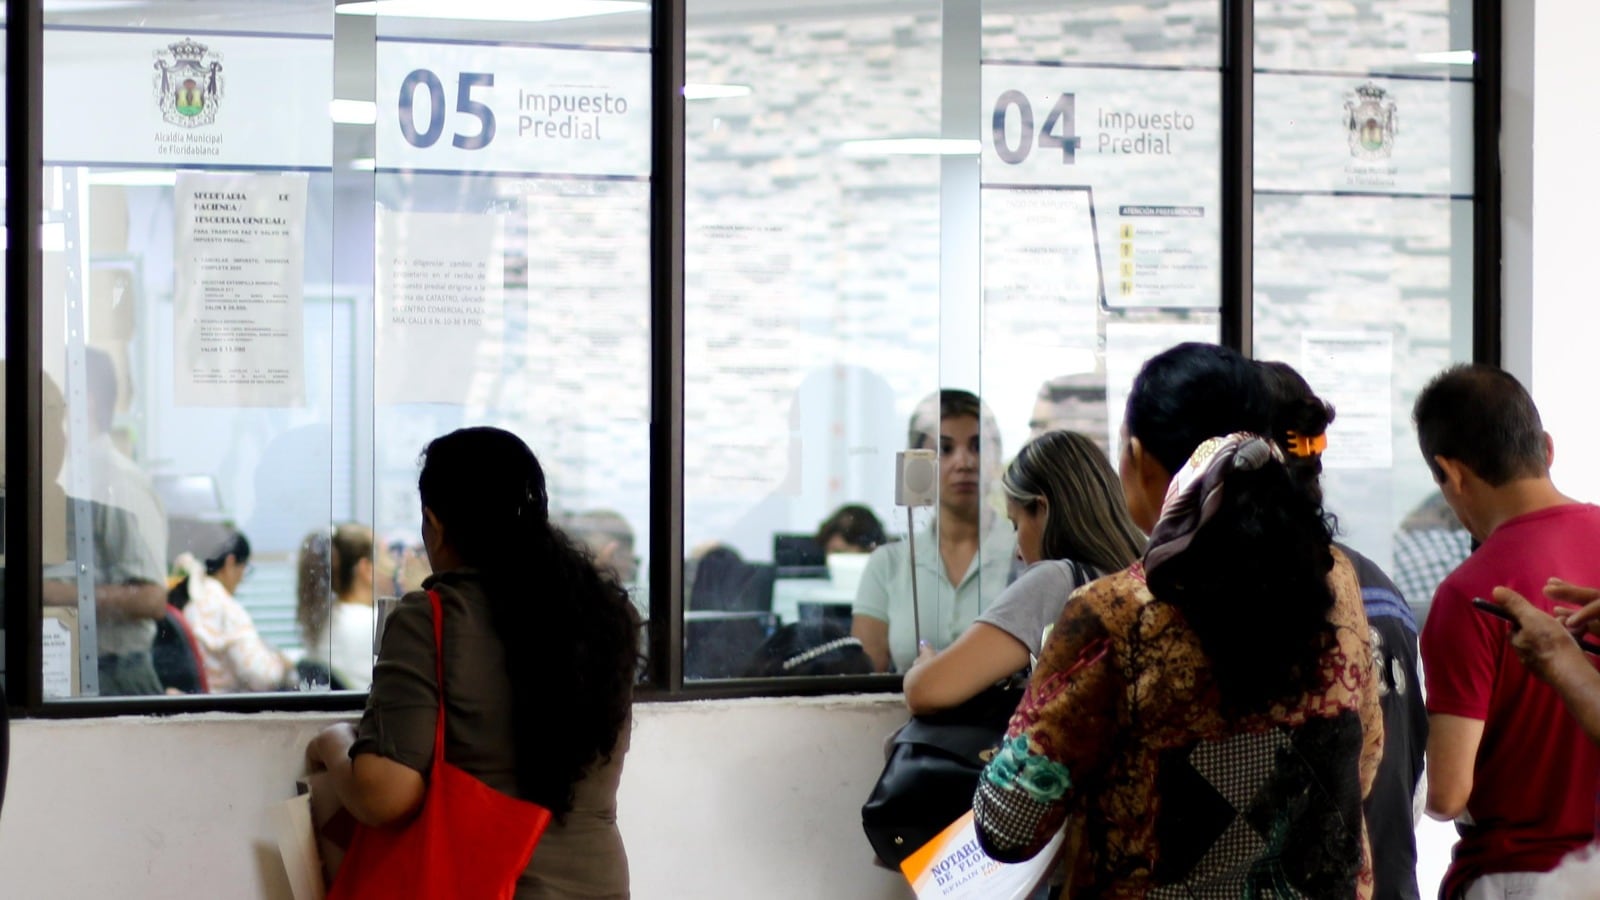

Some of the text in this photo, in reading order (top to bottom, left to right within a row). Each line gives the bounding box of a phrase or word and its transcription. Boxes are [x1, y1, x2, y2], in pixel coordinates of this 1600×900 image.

[398, 68, 497, 151] 05
[518, 88, 628, 117] Impuesto
[518, 115, 601, 140] Predial
[992, 89, 1081, 165] 04
[1098, 107, 1195, 133] Impuesto
[158, 144, 220, 156] de Floridablanca
[186, 132, 223, 145] Municipal
[1098, 132, 1172, 155] Predial
[936, 871, 954, 887] DE
